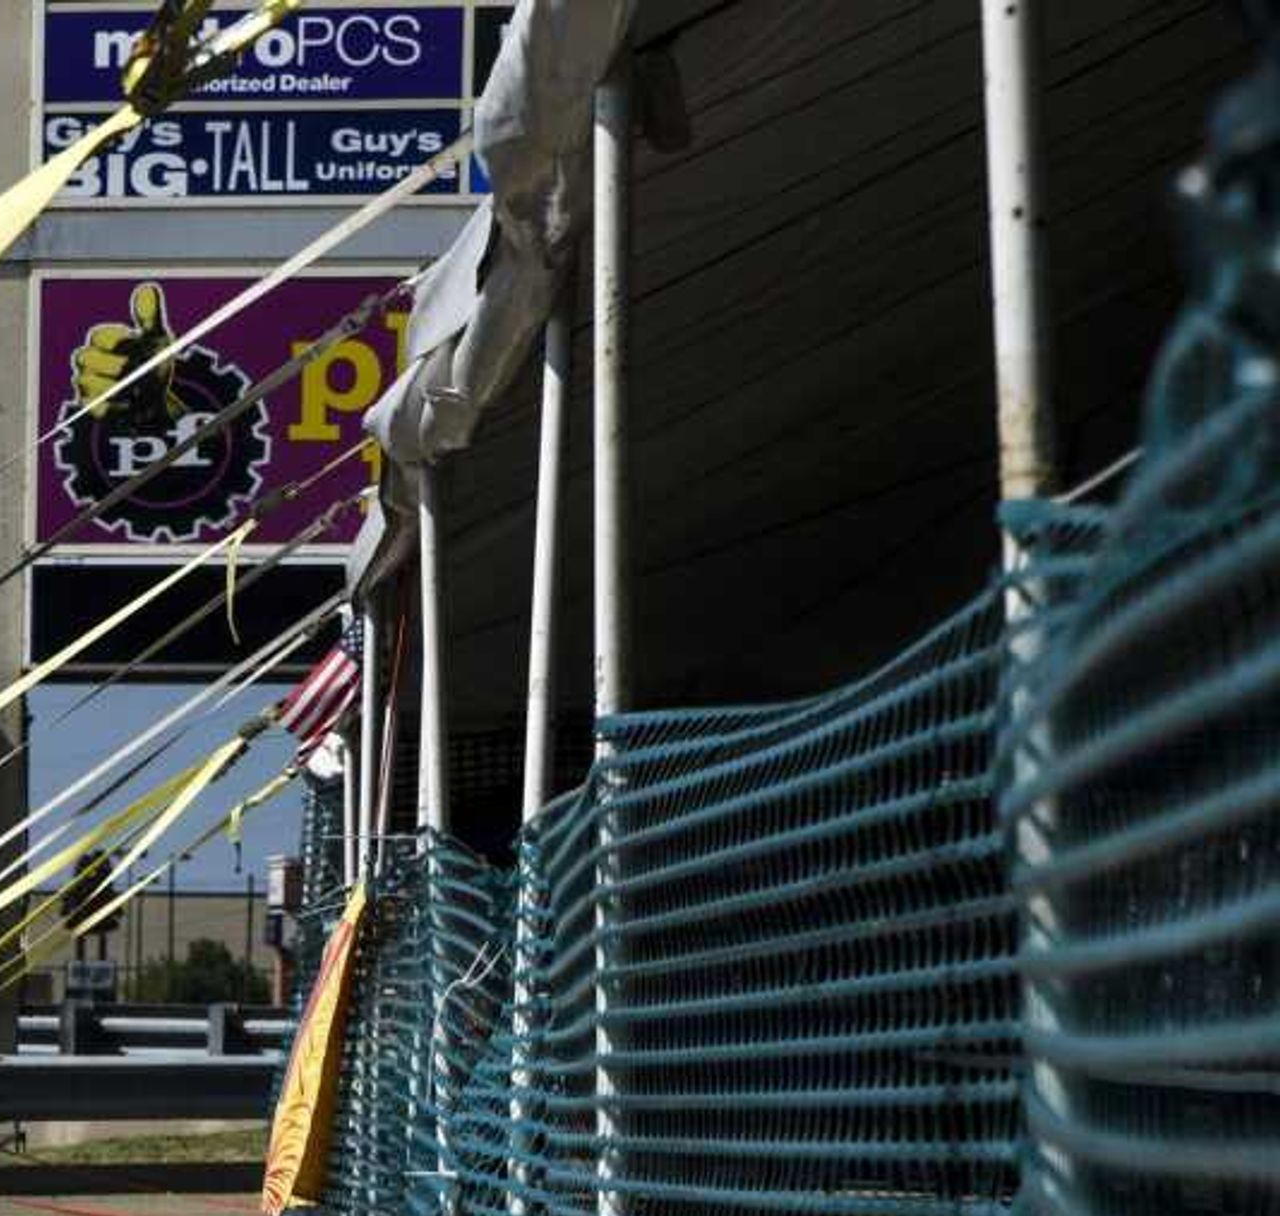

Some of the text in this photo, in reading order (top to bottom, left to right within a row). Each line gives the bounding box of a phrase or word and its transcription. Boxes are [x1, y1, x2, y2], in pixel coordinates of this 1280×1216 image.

[93, 15, 421, 68] moPCS
[192, 73, 353, 92] orized Dealer
[46, 117, 183, 152] Gy's
[330, 128, 443, 157] Guy's
[315, 161, 456, 180] Unifors
[108, 412, 217, 477] pf
